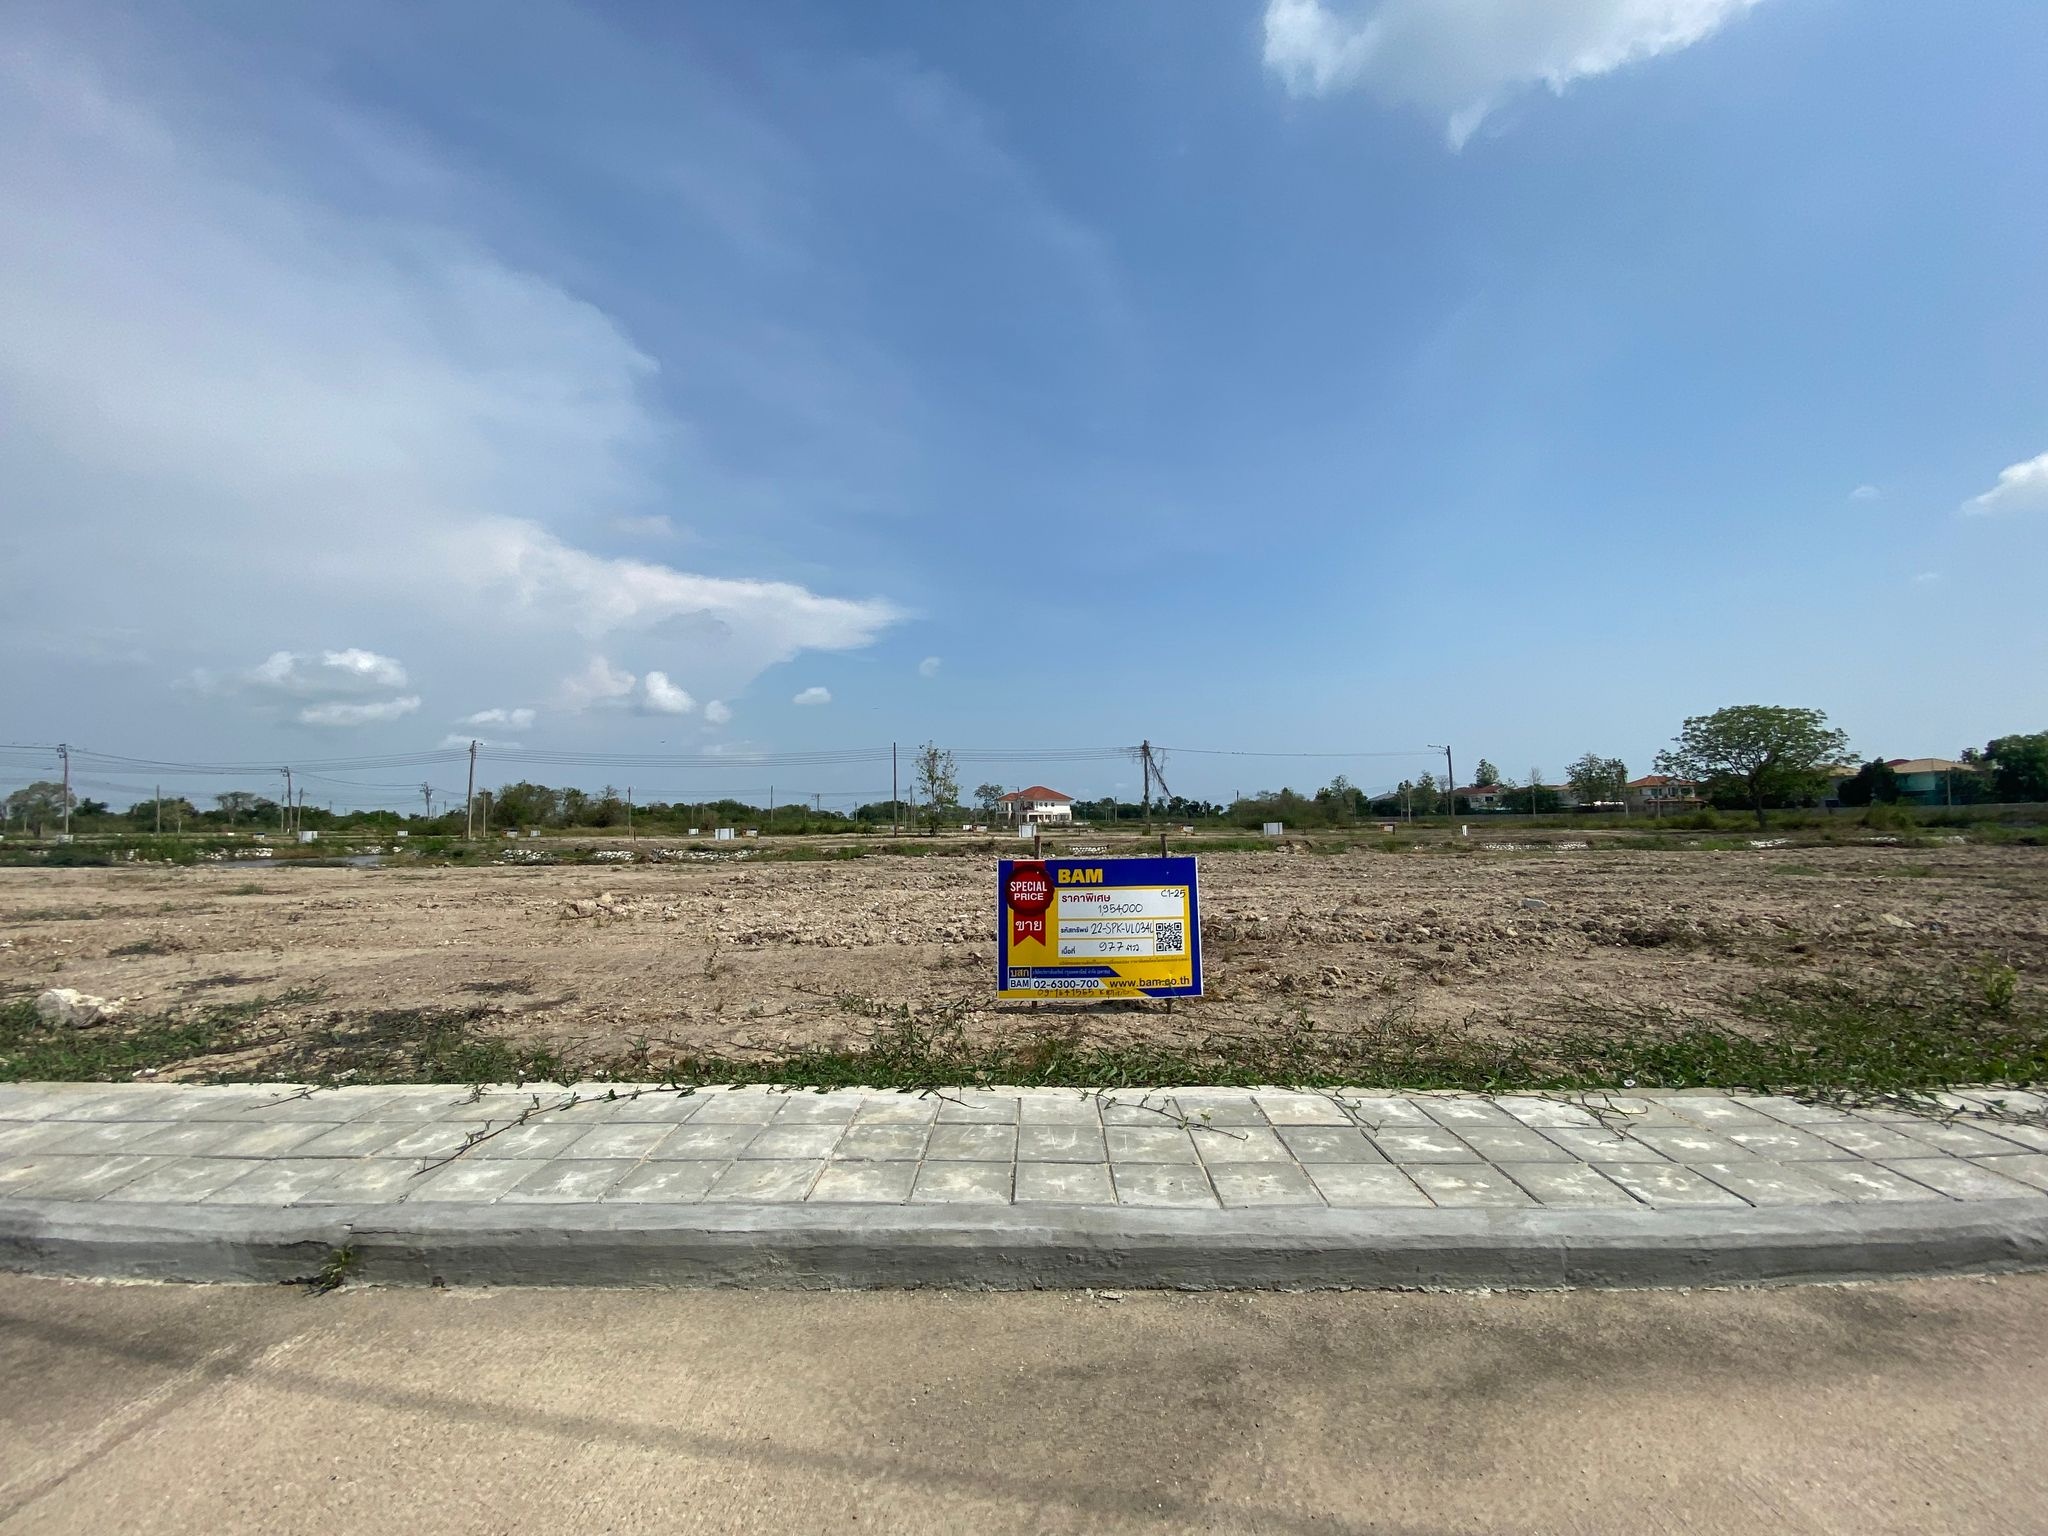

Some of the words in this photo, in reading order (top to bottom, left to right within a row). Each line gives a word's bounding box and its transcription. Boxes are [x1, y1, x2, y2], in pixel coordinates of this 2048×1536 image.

[1058, 868, 1103, 884] BAM
[1010, 880, 1047, 892] SPECIAL
[1013, 893, 1044, 901] PRICE
[1061, 892, 1111, 903] ราคาพิเศษ
[1015, 920, 1043, 932] ขาย
[1010, 978, 1029, 988] BAM
[1033, 979, 1099, 989] 02-6300-700
[1109, 976, 1190, 988] www.bam.co.th
